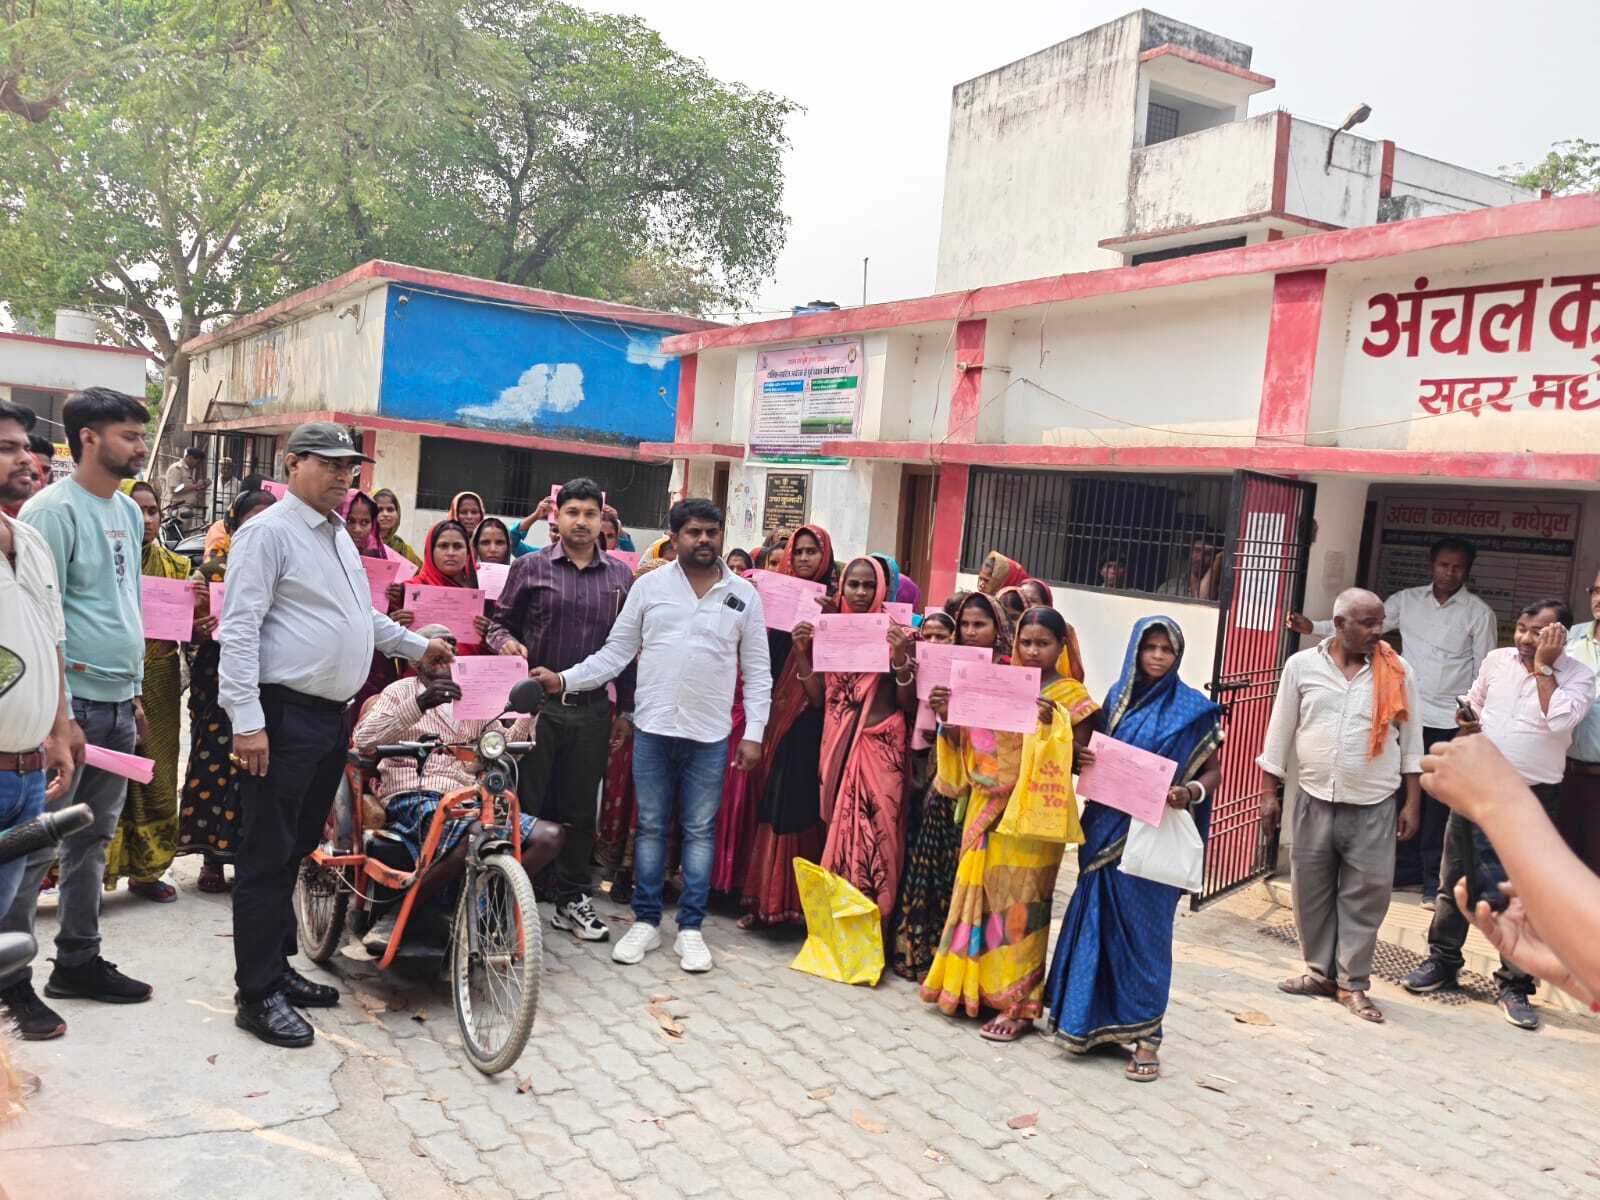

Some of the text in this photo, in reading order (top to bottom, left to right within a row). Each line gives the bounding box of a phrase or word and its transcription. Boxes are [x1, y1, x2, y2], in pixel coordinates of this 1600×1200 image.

[1362, 277, 1544, 357] अंचल
[1418, 376, 1518, 417] सदर
[1387, 503, 1570, 537] अंचल कार्यालय, मधेपुरा
